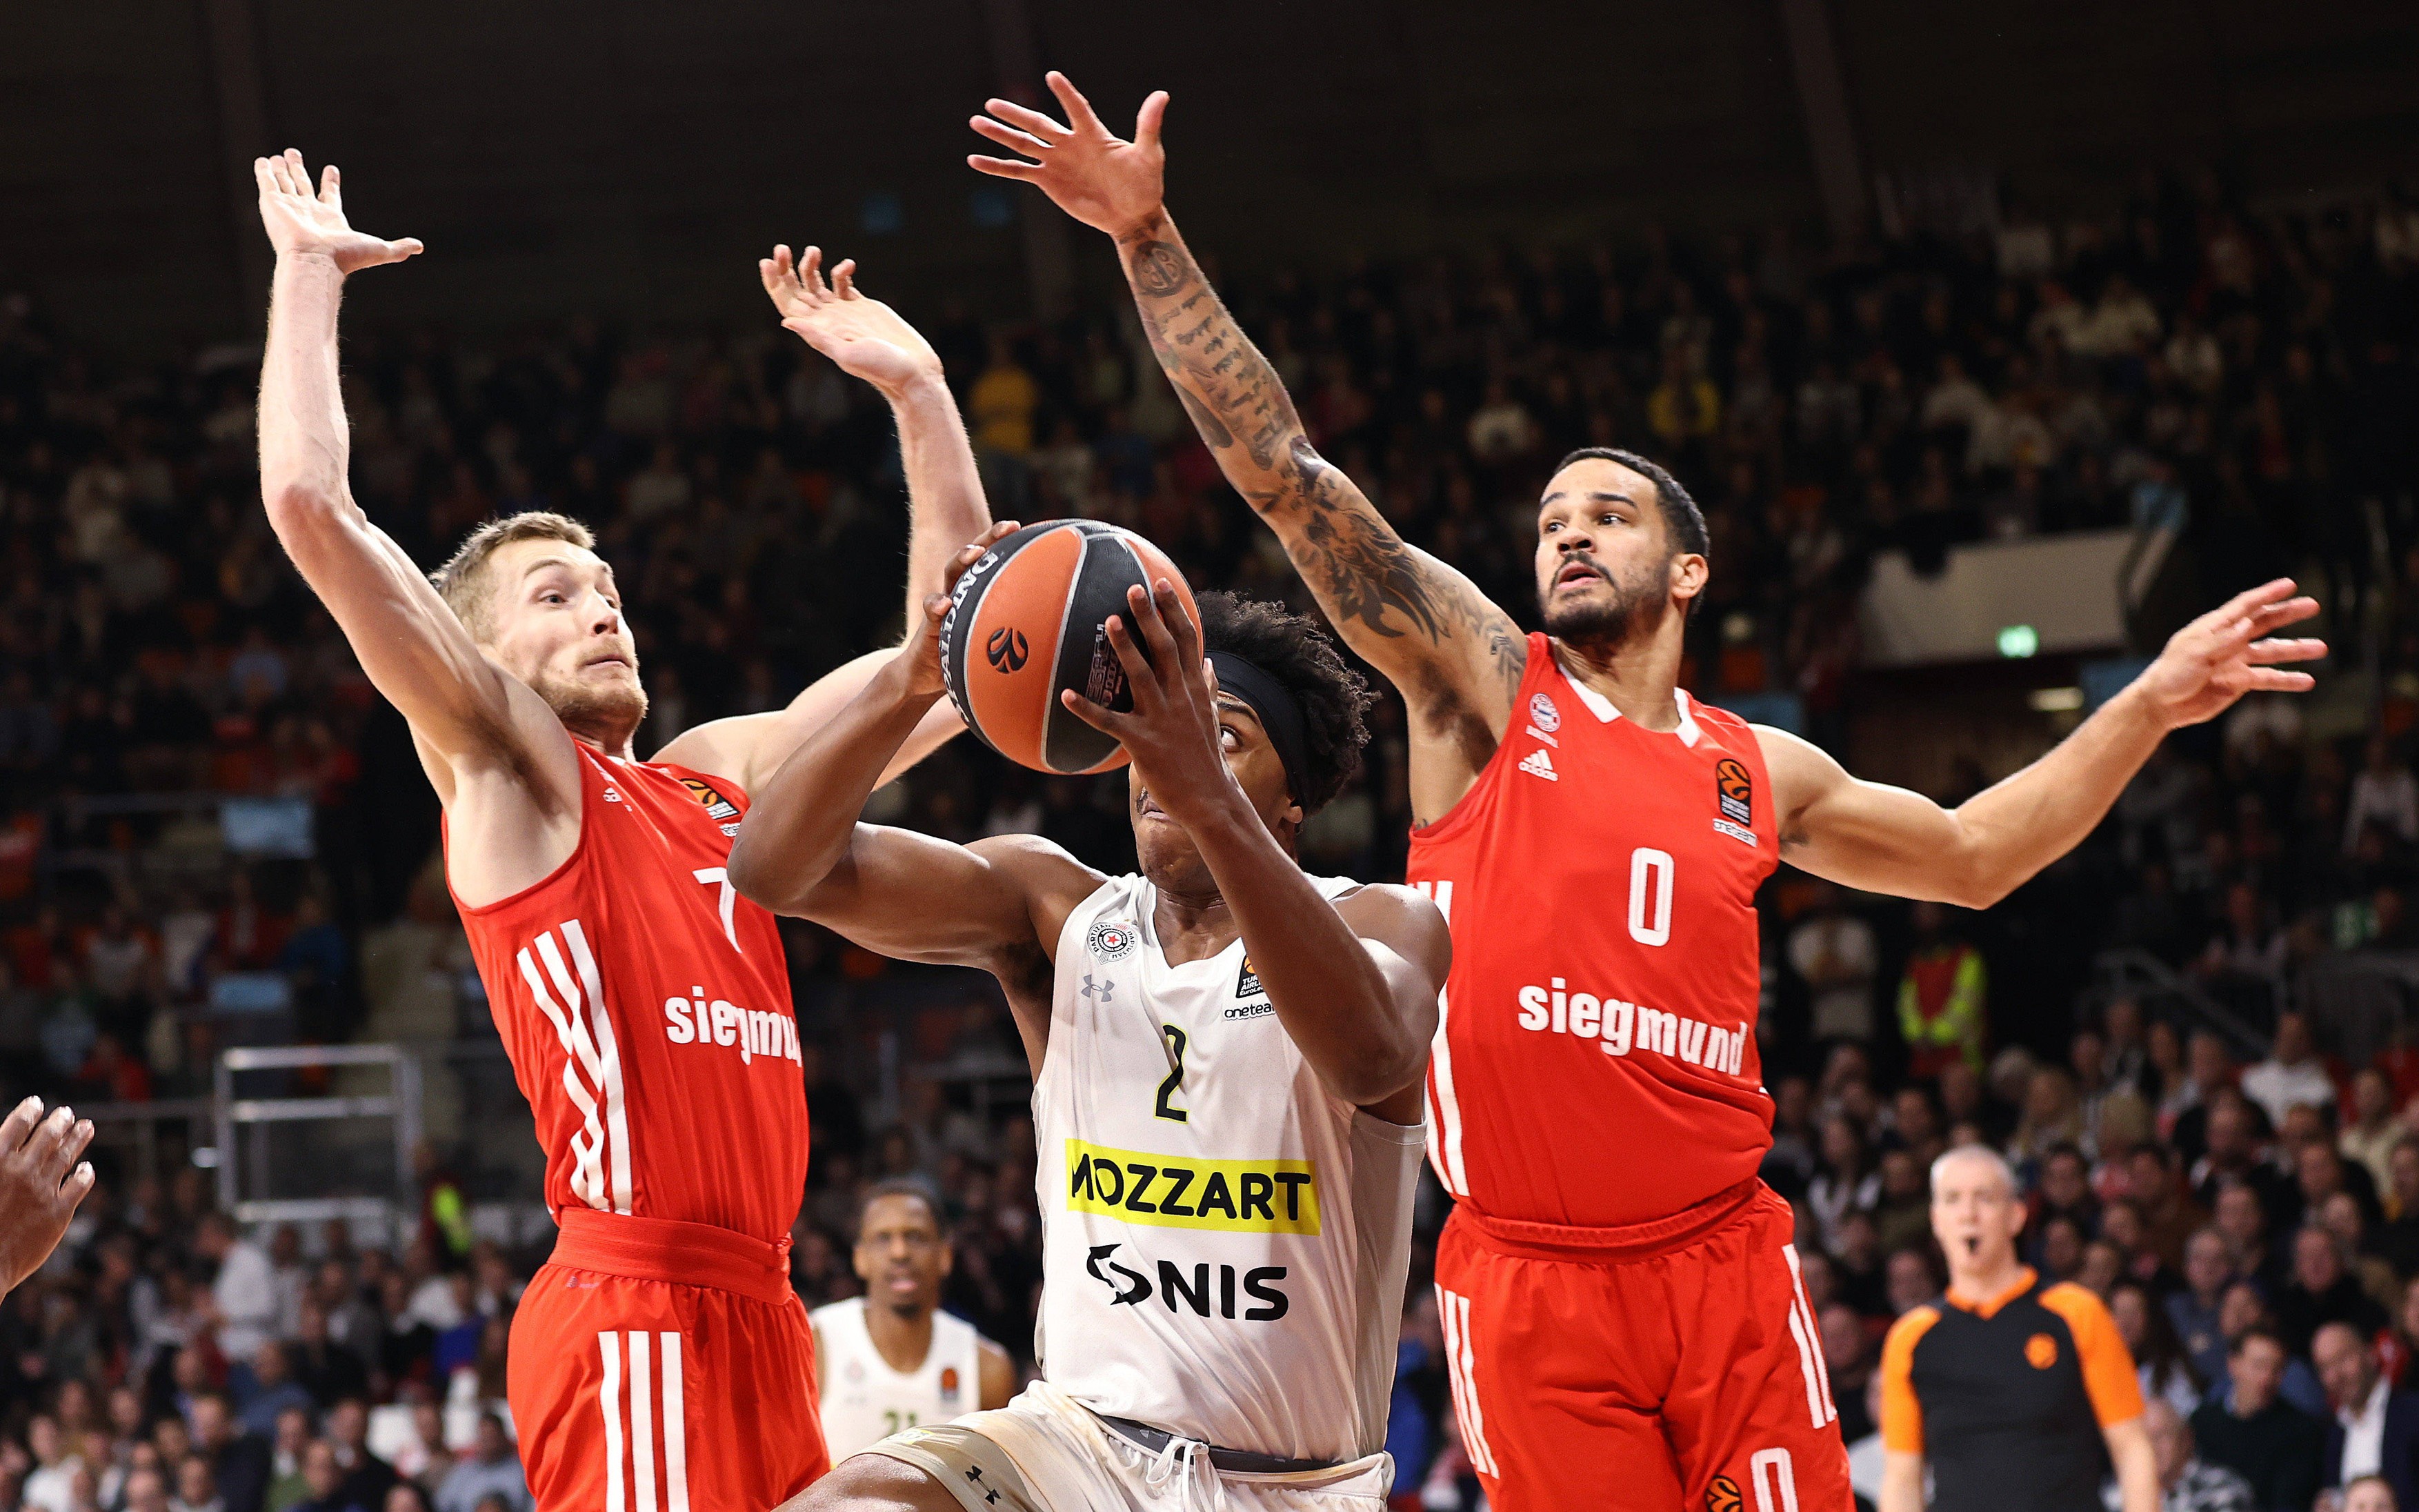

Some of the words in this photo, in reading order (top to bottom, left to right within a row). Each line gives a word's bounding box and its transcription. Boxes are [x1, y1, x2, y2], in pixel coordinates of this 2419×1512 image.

[692, 867, 744, 954] 7
[1628, 847, 1675, 947] 0
[1090, 924, 1111, 953] PARTIZAN
[1224, 1003, 1275, 1018] onetea
[1242, 975, 1258, 984] TUR
[664, 985, 802, 1068] siegmu
[1517, 977, 1749, 1076] siegmund
[1154, 1023, 1188, 1124] 2
[1071, 1153, 1311, 1221] MOZZART
[1157, 1260, 1289, 1322] NIS
